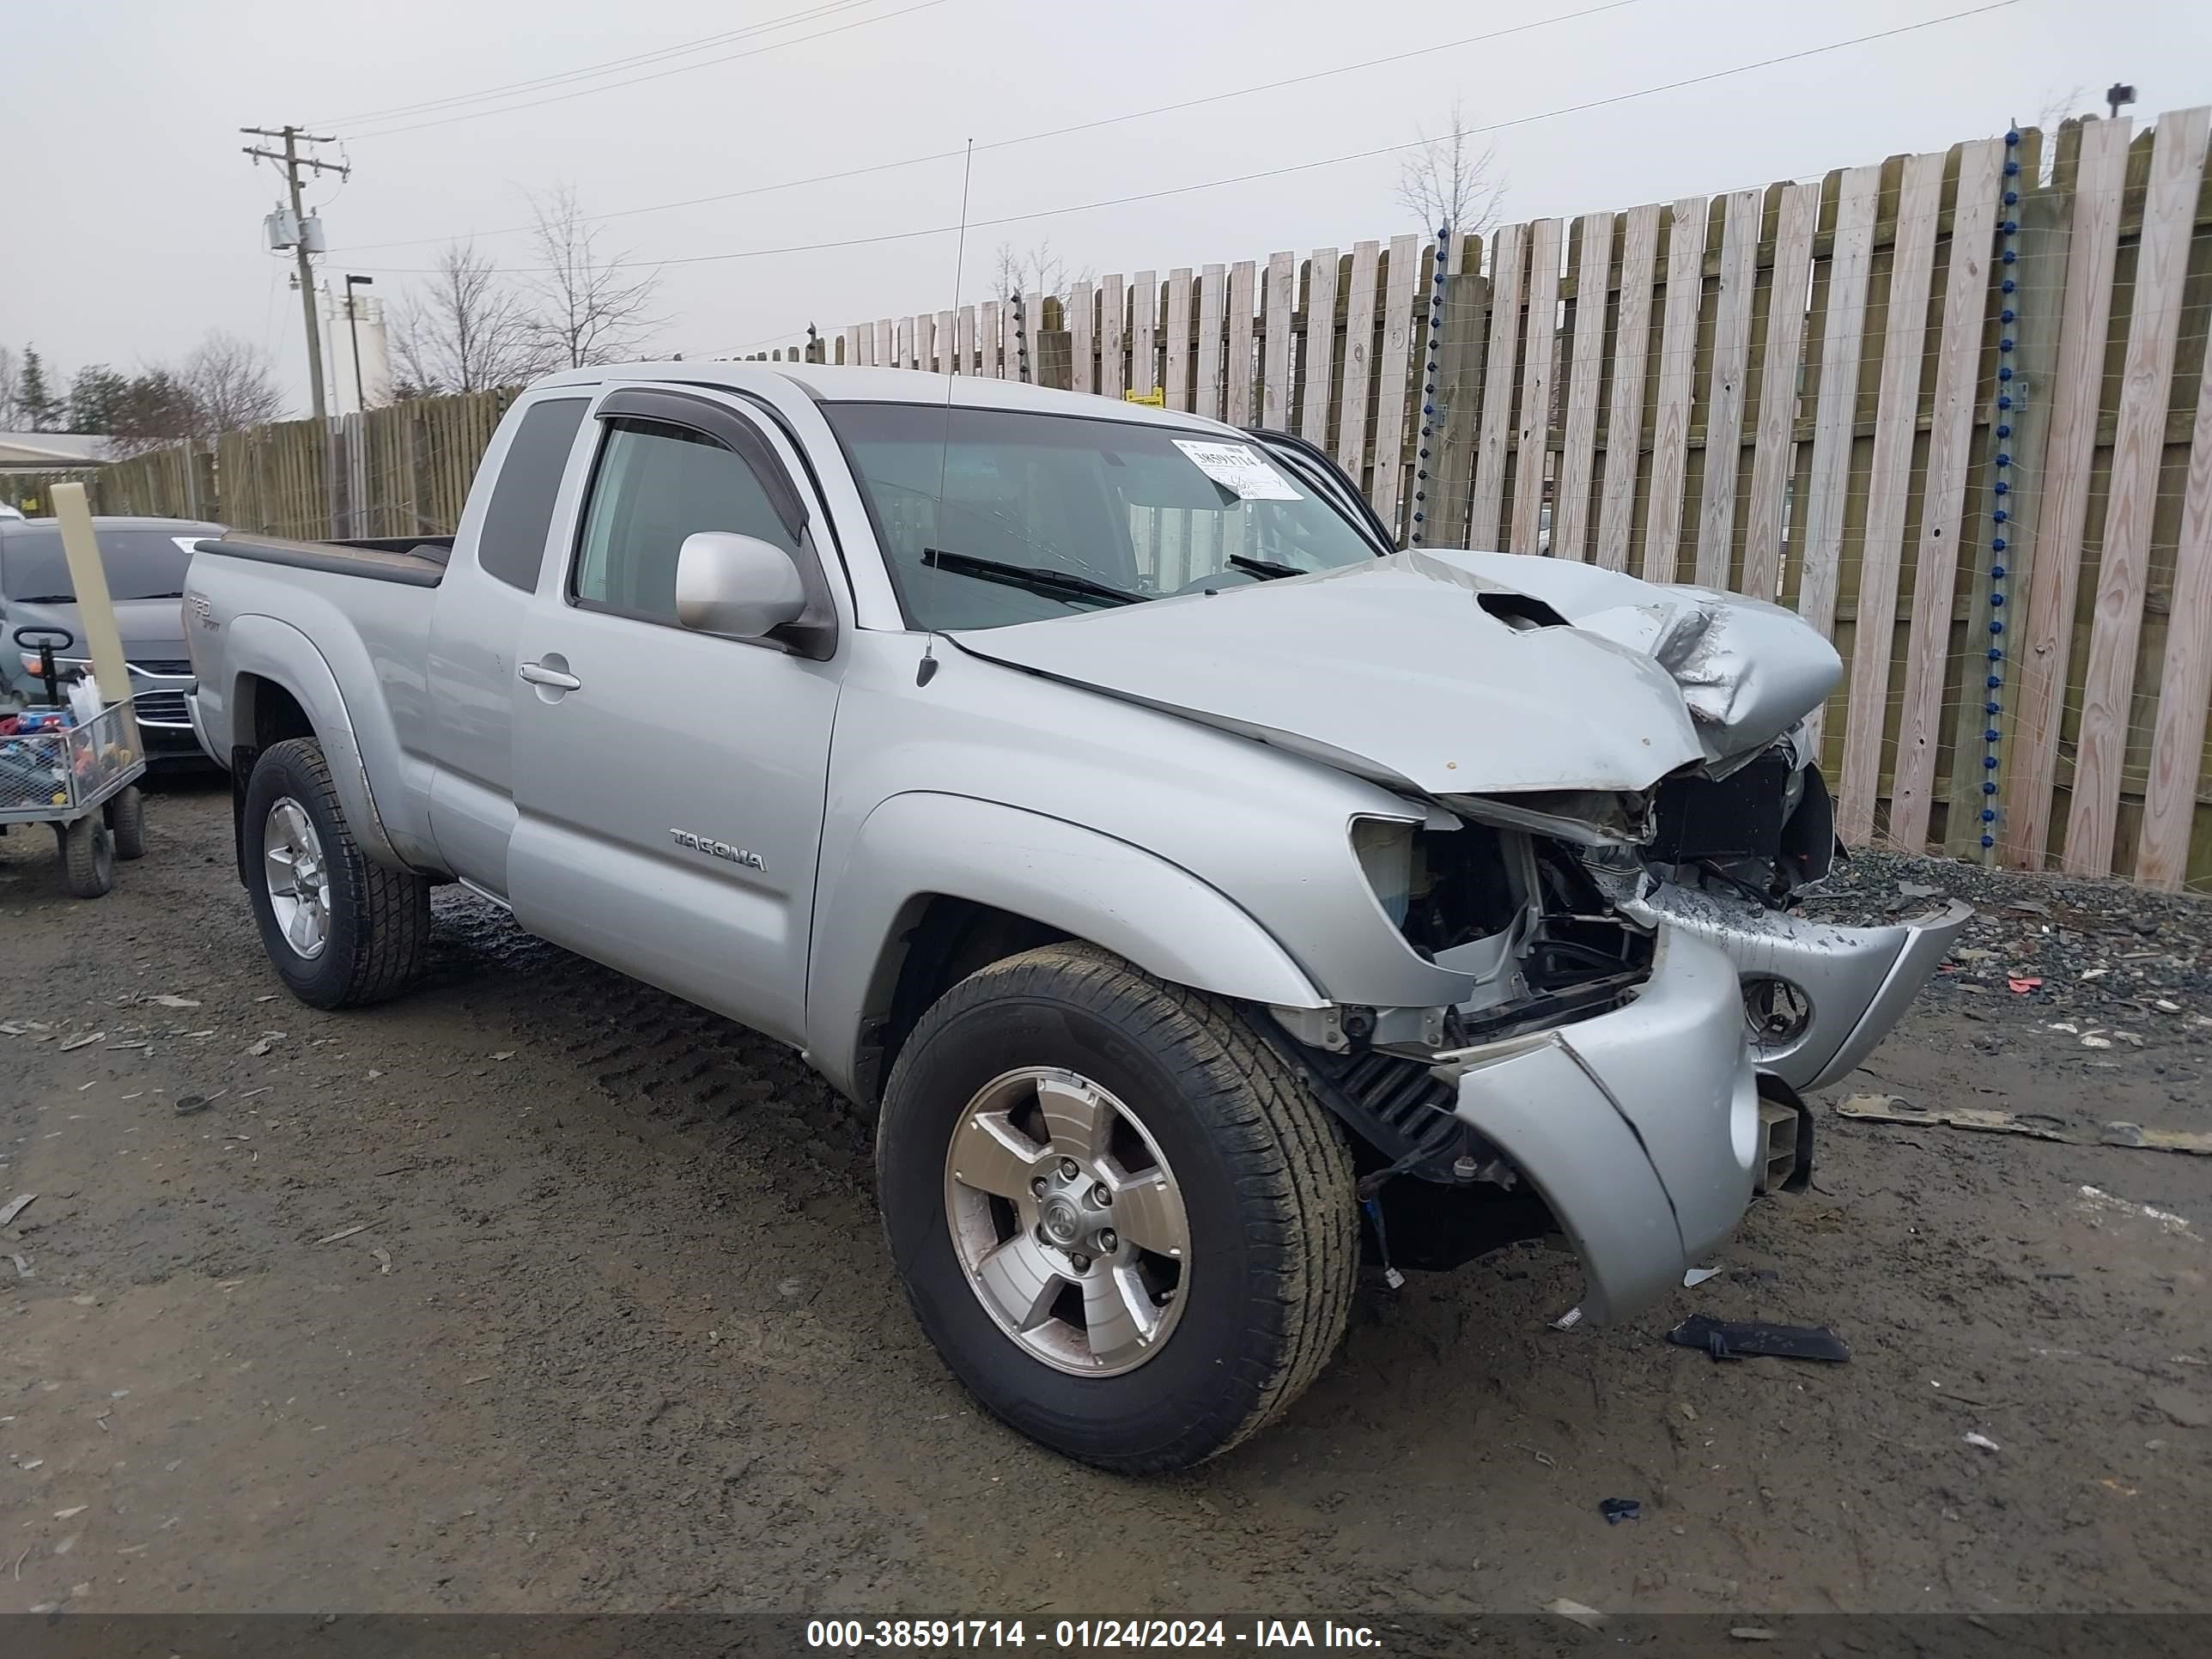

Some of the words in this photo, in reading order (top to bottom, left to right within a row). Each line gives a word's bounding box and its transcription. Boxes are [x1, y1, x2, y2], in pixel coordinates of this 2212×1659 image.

[1194, 453, 1258, 467] 38591714
[189, 596, 211, 617] TRD
[669, 828, 769, 872] TACOMA
